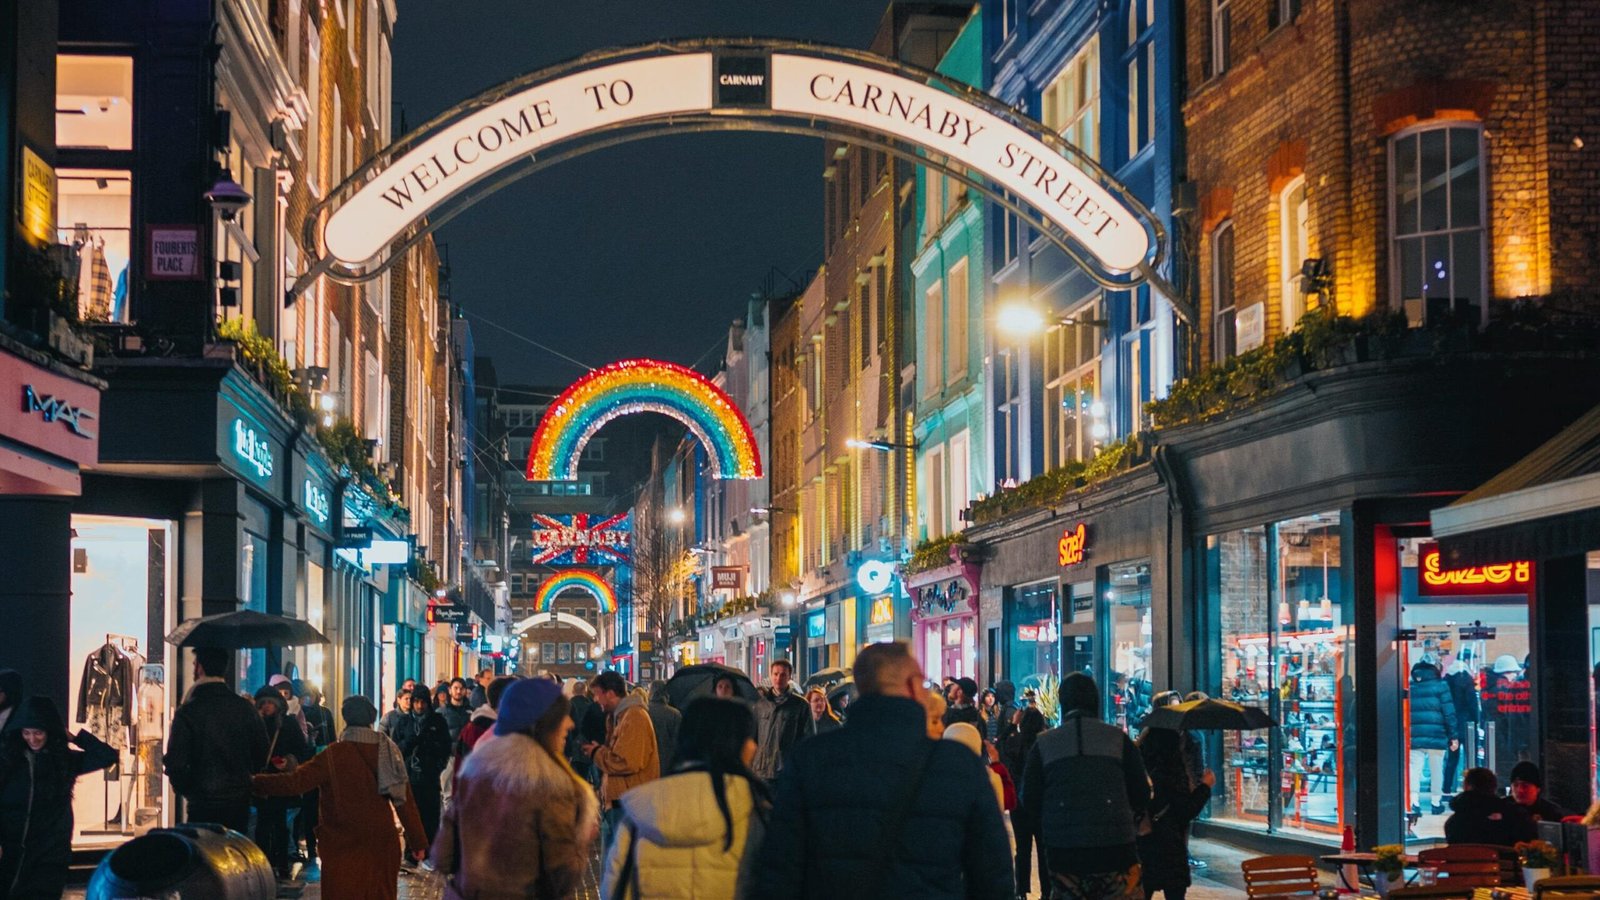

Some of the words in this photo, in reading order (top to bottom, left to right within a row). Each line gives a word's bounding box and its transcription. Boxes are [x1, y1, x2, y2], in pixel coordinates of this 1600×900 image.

[720, 74, 764, 86] CARNABY
[380, 100, 558, 212] WELCOME
[584, 79, 635, 113] TO
[809, 72, 987, 147] CARNABY
[997, 142, 1120, 239] STREET
[154, 240, 198, 255] FOUBERTS
[157, 256, 184, 272] PLACE
[1058, 523, 1086, 567] size?
[716, 572, 736, 582] MUJI
